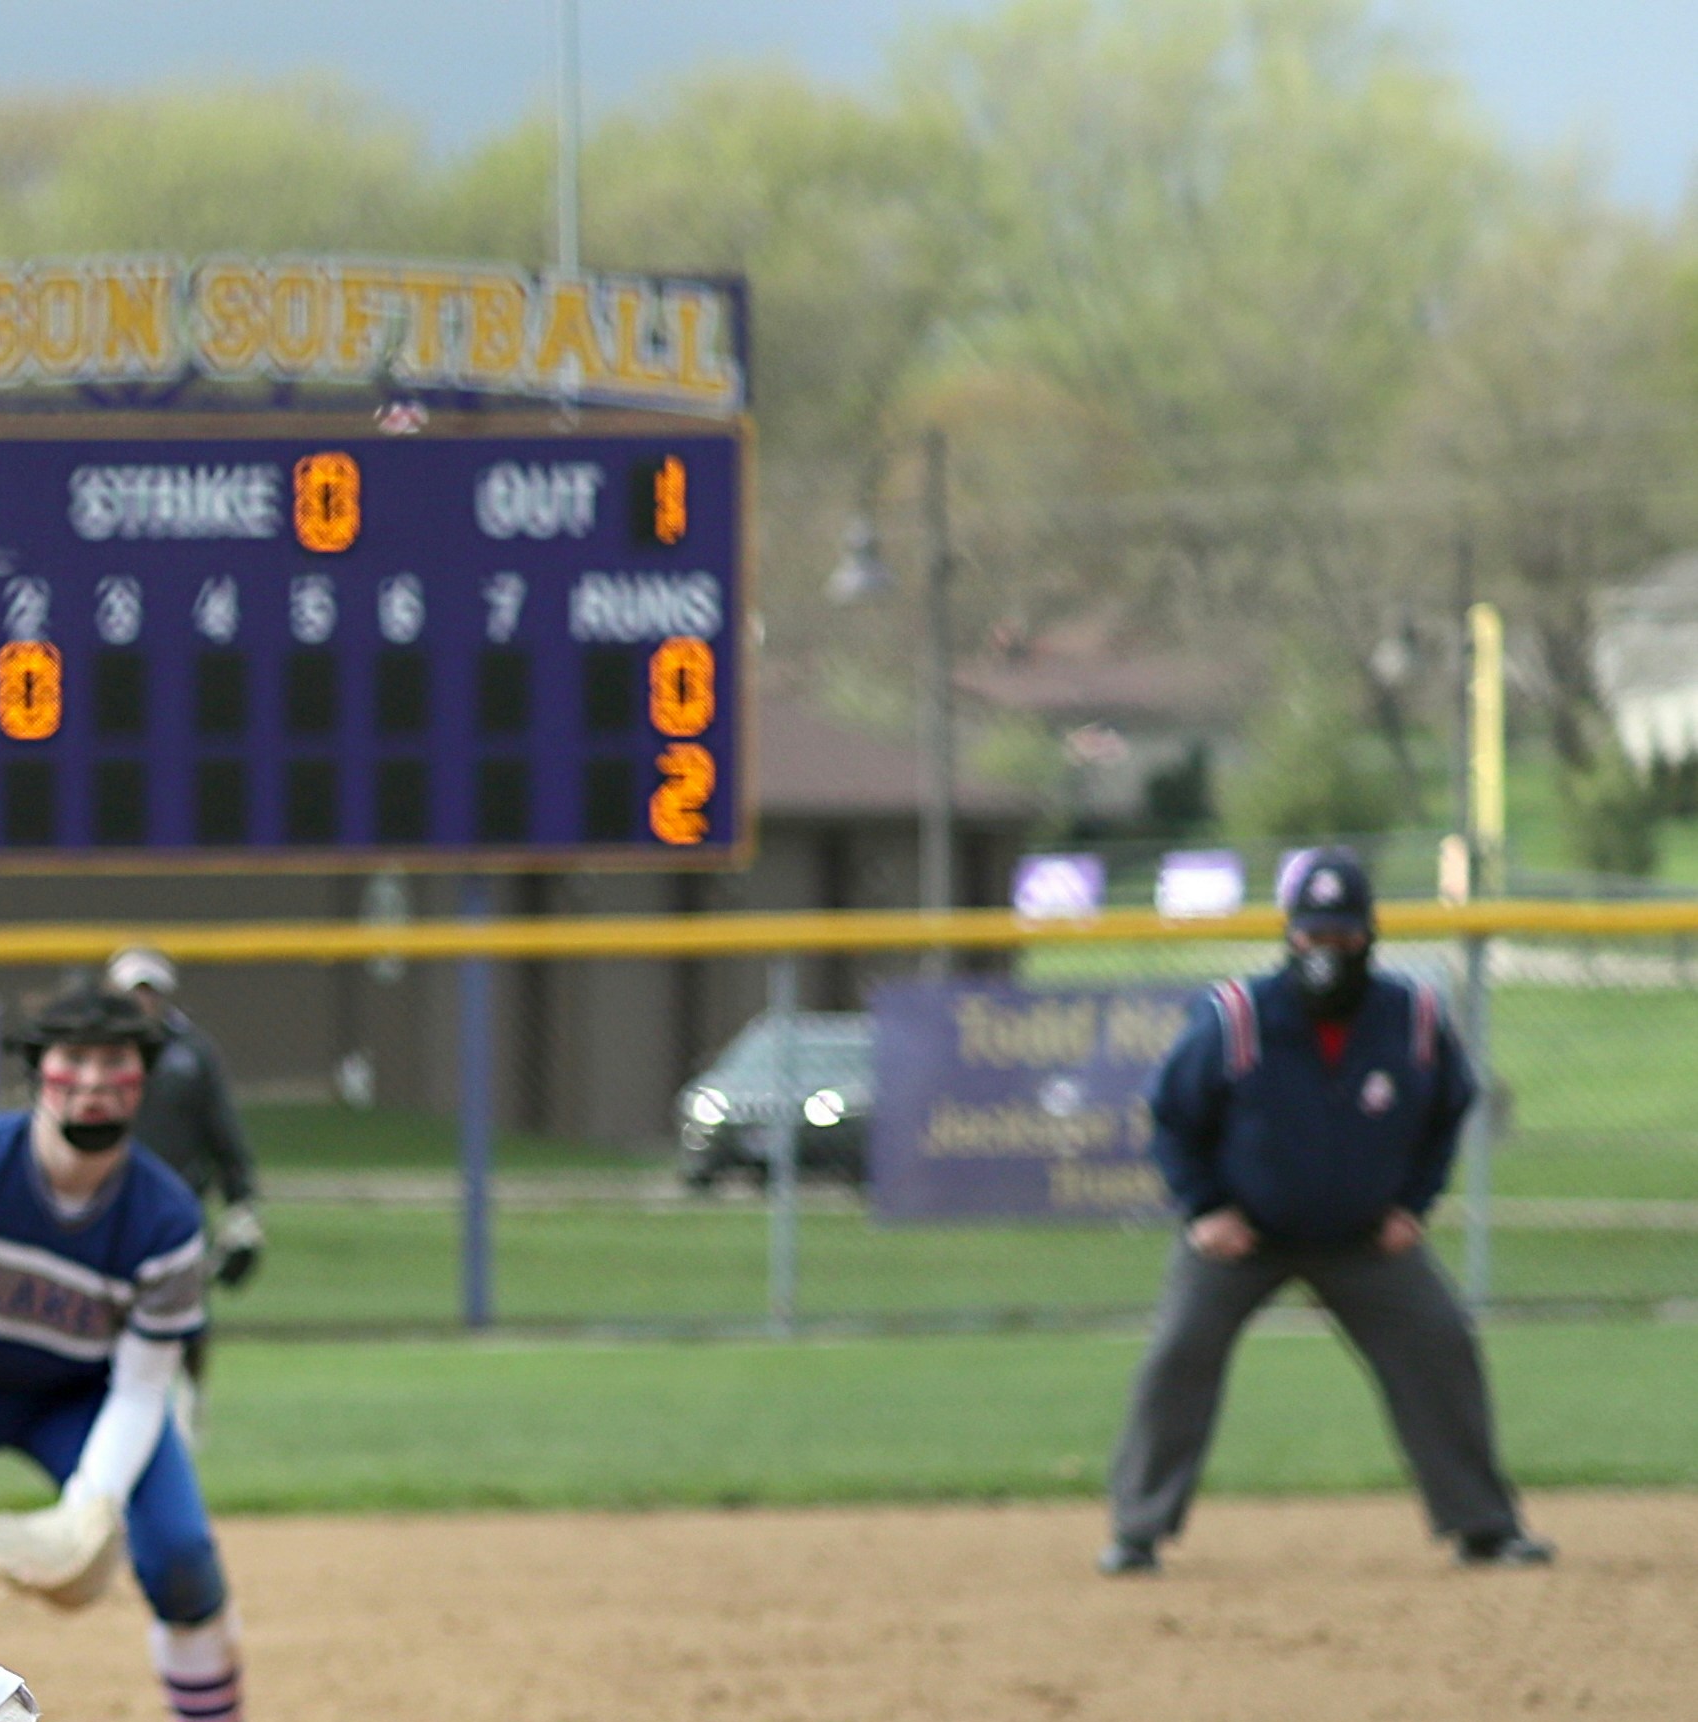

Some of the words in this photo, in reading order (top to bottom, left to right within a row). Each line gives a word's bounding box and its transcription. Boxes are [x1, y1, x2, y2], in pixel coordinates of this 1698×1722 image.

[195, 256, 739, 400] SOFTBALL
[68, 464, 281, 540] STRIKE
[293, 451, 361, 552] 0
[474, 462, 603, 540] OUT
[655, 454, 686, 544] 1
[4, 574, 50, 641] 2
[95, 574, 142, 645] 3
[193, 573, 239, 645] 4
[289, 574, 337, 645] 5
[378, 572, 425, 644] 6
[479, 571, 528, 643] 7
[568, 570, 723, 644] RUNS
[649, 635, 717, 738] 0
[649, 742, 716, 845] 2
